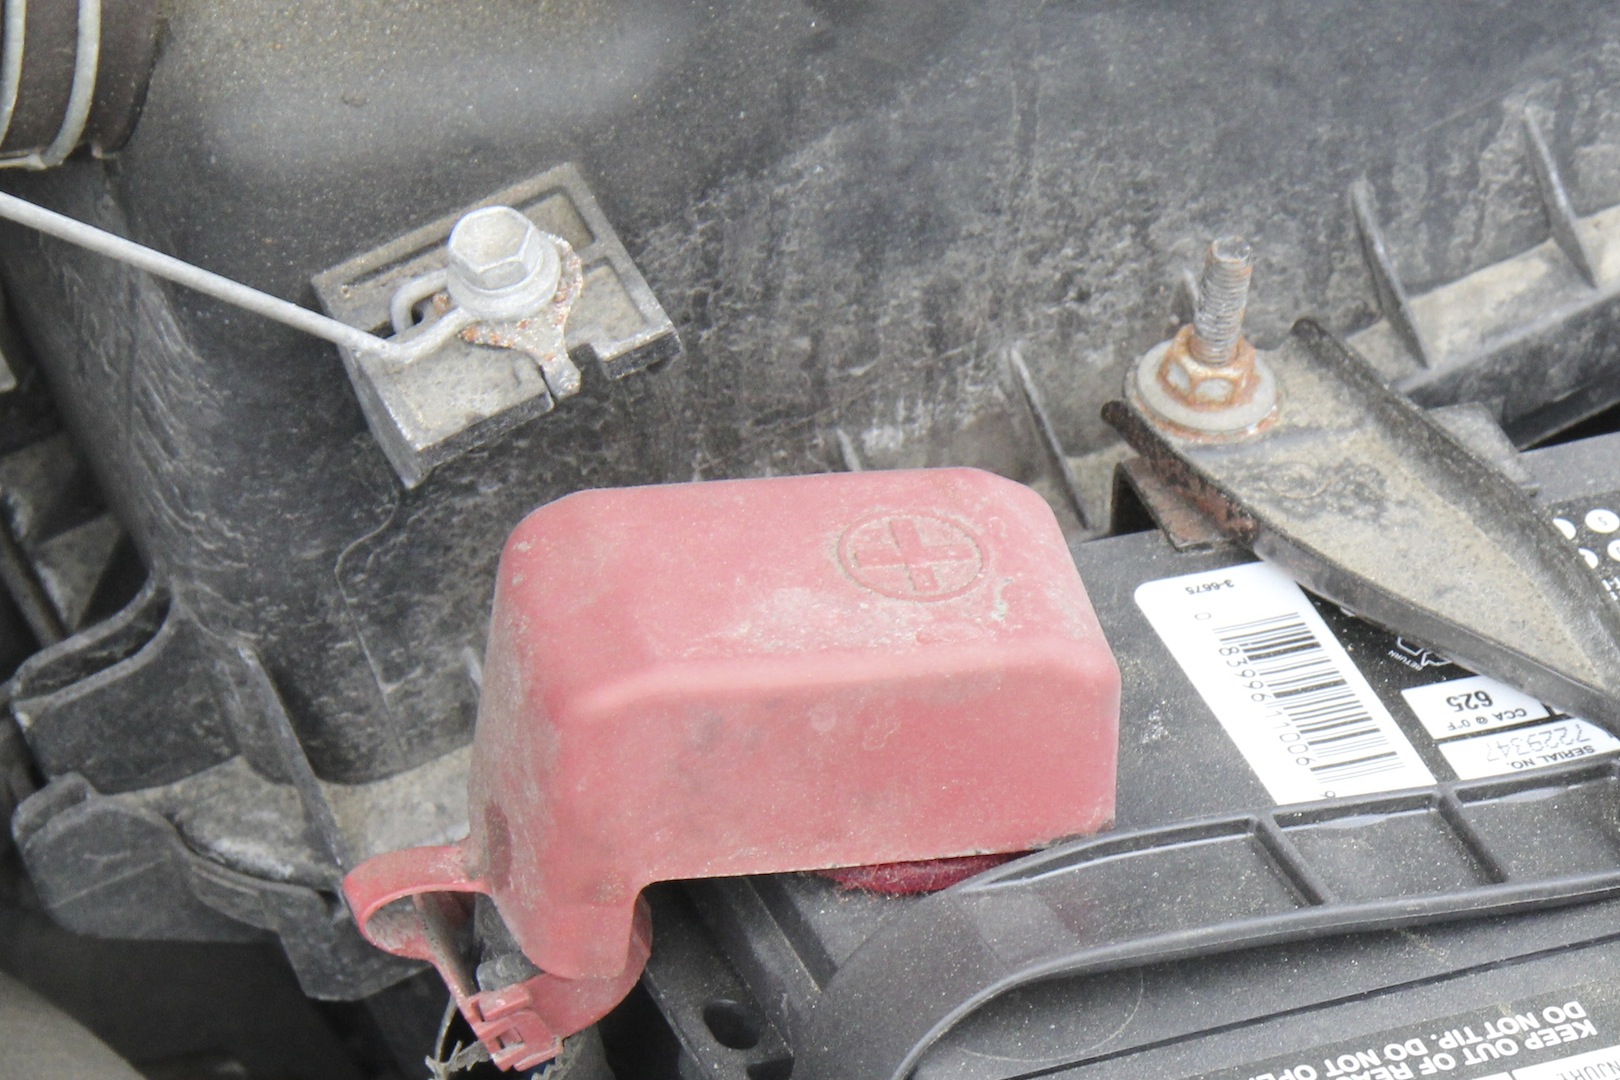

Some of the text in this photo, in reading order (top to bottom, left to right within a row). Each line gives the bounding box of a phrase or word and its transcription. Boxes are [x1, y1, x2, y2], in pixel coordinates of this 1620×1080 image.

[1185, 579, 1234, 595] 3-6675
[1386, 648, 1423, 671] RETURN
[1218, 646, 1272, 702] 83996
[1265, 710, 1316, 766] 11006
[1446, 690, 1493, 712] 625
[1493, 708, 1527, 721] CCA
[1506, 745, 1601, 770] SERIAL NO.
[1542, 1001, 1587, 1024] DO
[1484, 1012, 1541, 1039] NOT
[1524, 1019, 1598, 1050] KEEP
[1430, 1026, 1484, 1049] TIP.
[1384, 1038, 1429, 1061] DO
[1462, 1038, 1519, 1065] OUT
[1324, 1049, 1382, 1077] NOT
[1419, 1052, 1456, 1075] OF
